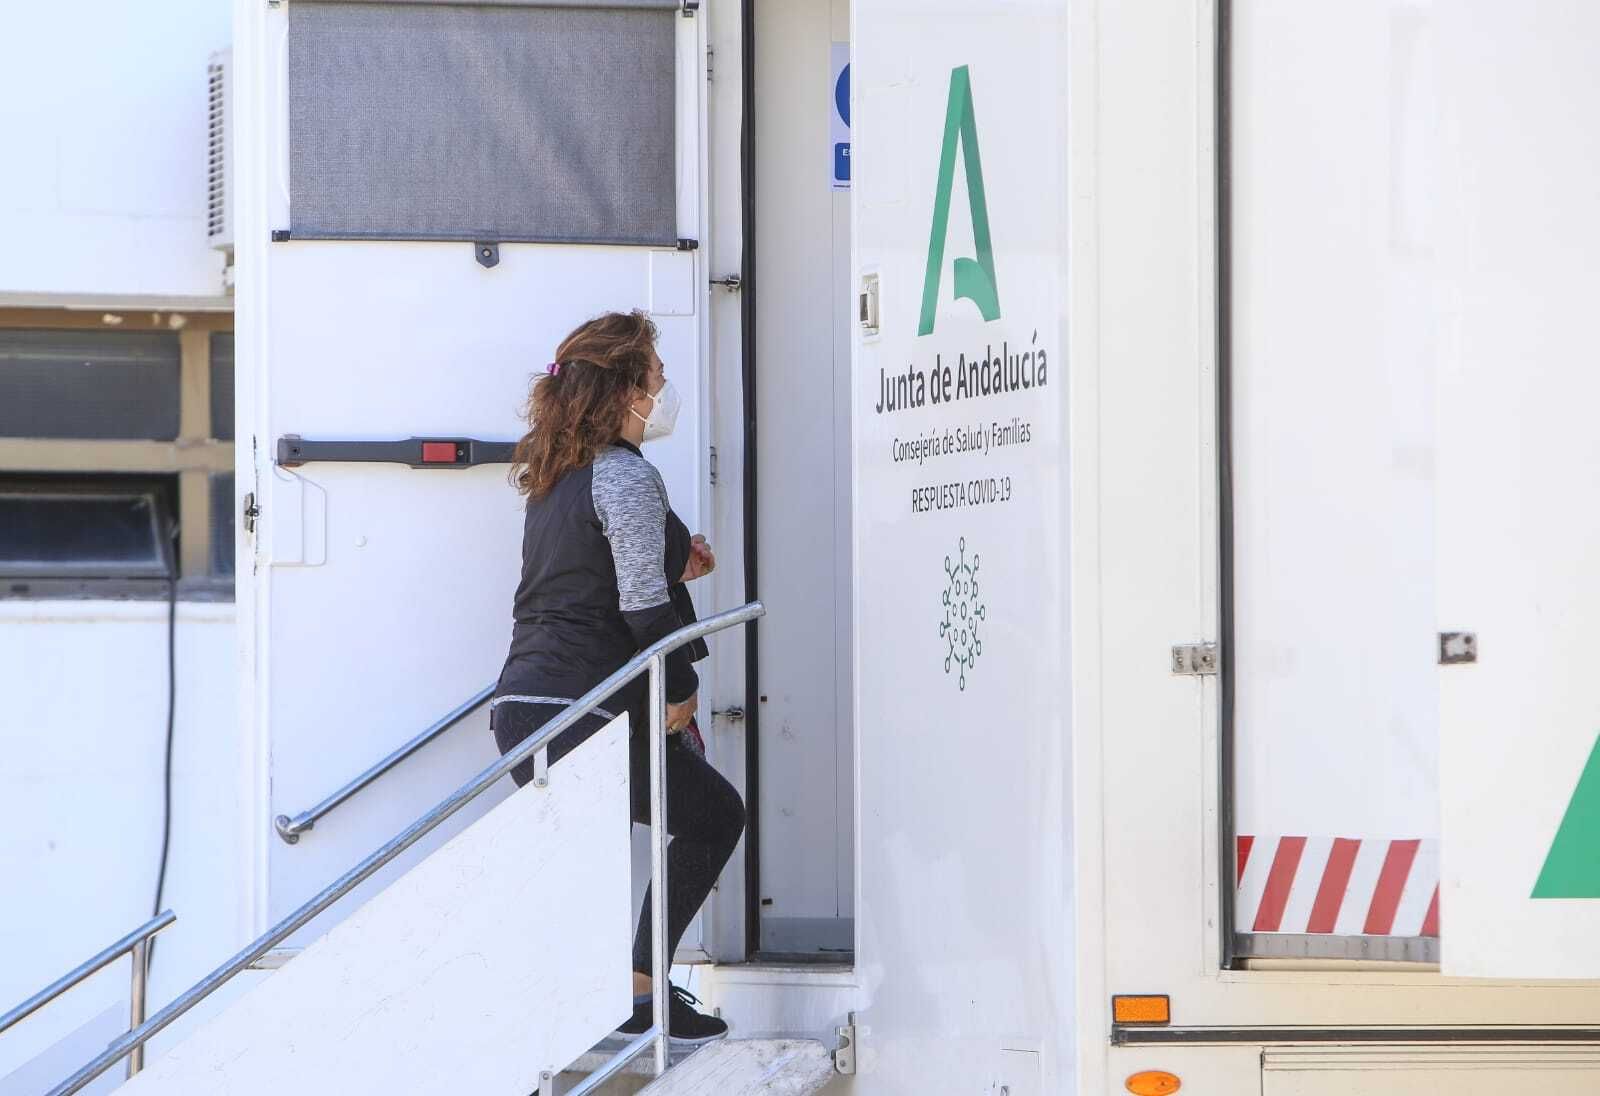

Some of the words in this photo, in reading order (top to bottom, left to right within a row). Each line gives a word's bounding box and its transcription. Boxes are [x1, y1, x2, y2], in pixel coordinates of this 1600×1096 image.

[876, 365, 925, 414] Junta
[930, 354, 952, 403] de
[956, 329, 1048, 400] Andalucía
[892, 427, 941, 465] Consejería
[942, 427, 954, 455] de
[956, 423, 983, 452] Salud
[984, 429, 990, 456] y
[991, 417, 1031, 447] Familias
[912, 482, 966, 514] RESPUESTA
[968, 477, 1011, 506] COVID-19
